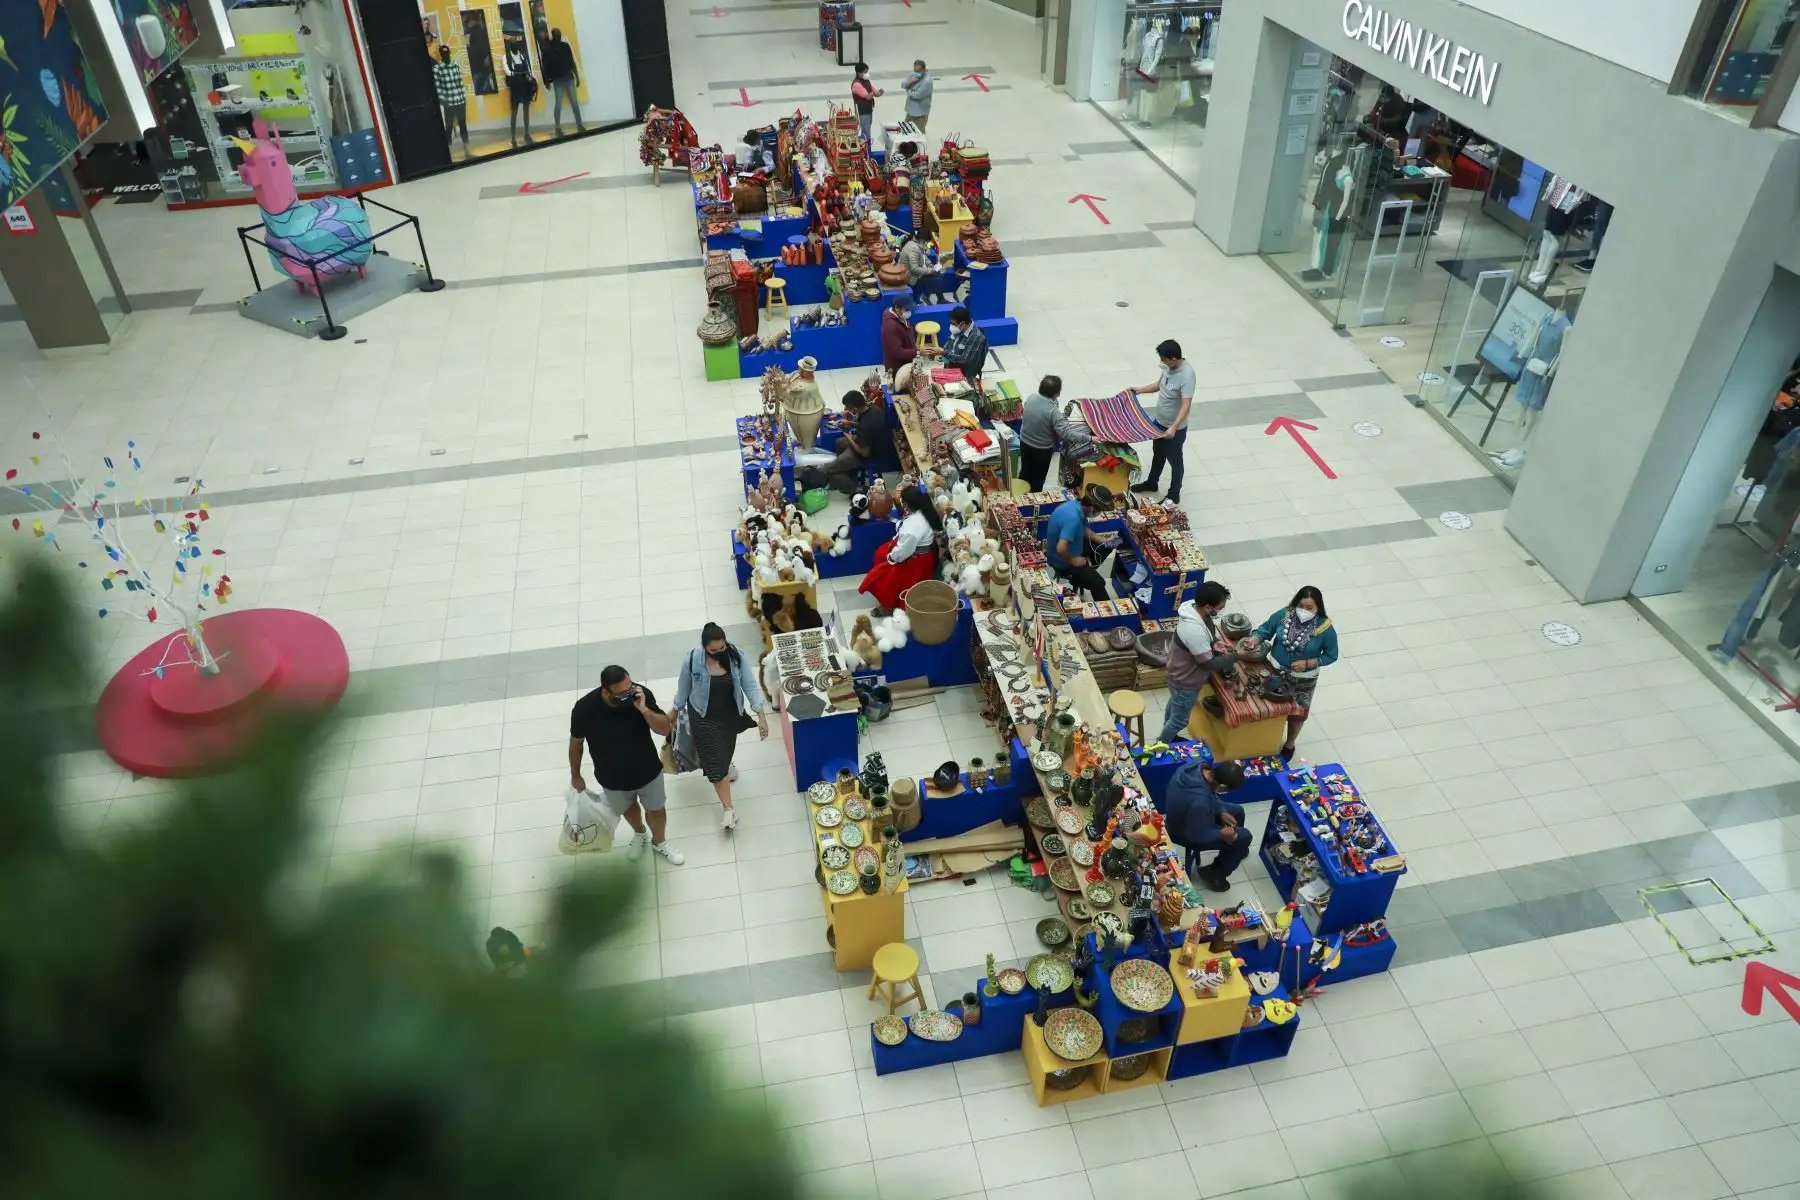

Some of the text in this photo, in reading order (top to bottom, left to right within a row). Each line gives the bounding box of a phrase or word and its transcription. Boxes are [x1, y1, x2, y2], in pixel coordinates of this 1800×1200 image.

[1342, 0, 1498, 105] CALVIN KLEIN
[112, 183, 162, 193] WELCO
[1509, 322, 1527, 340] 30%
